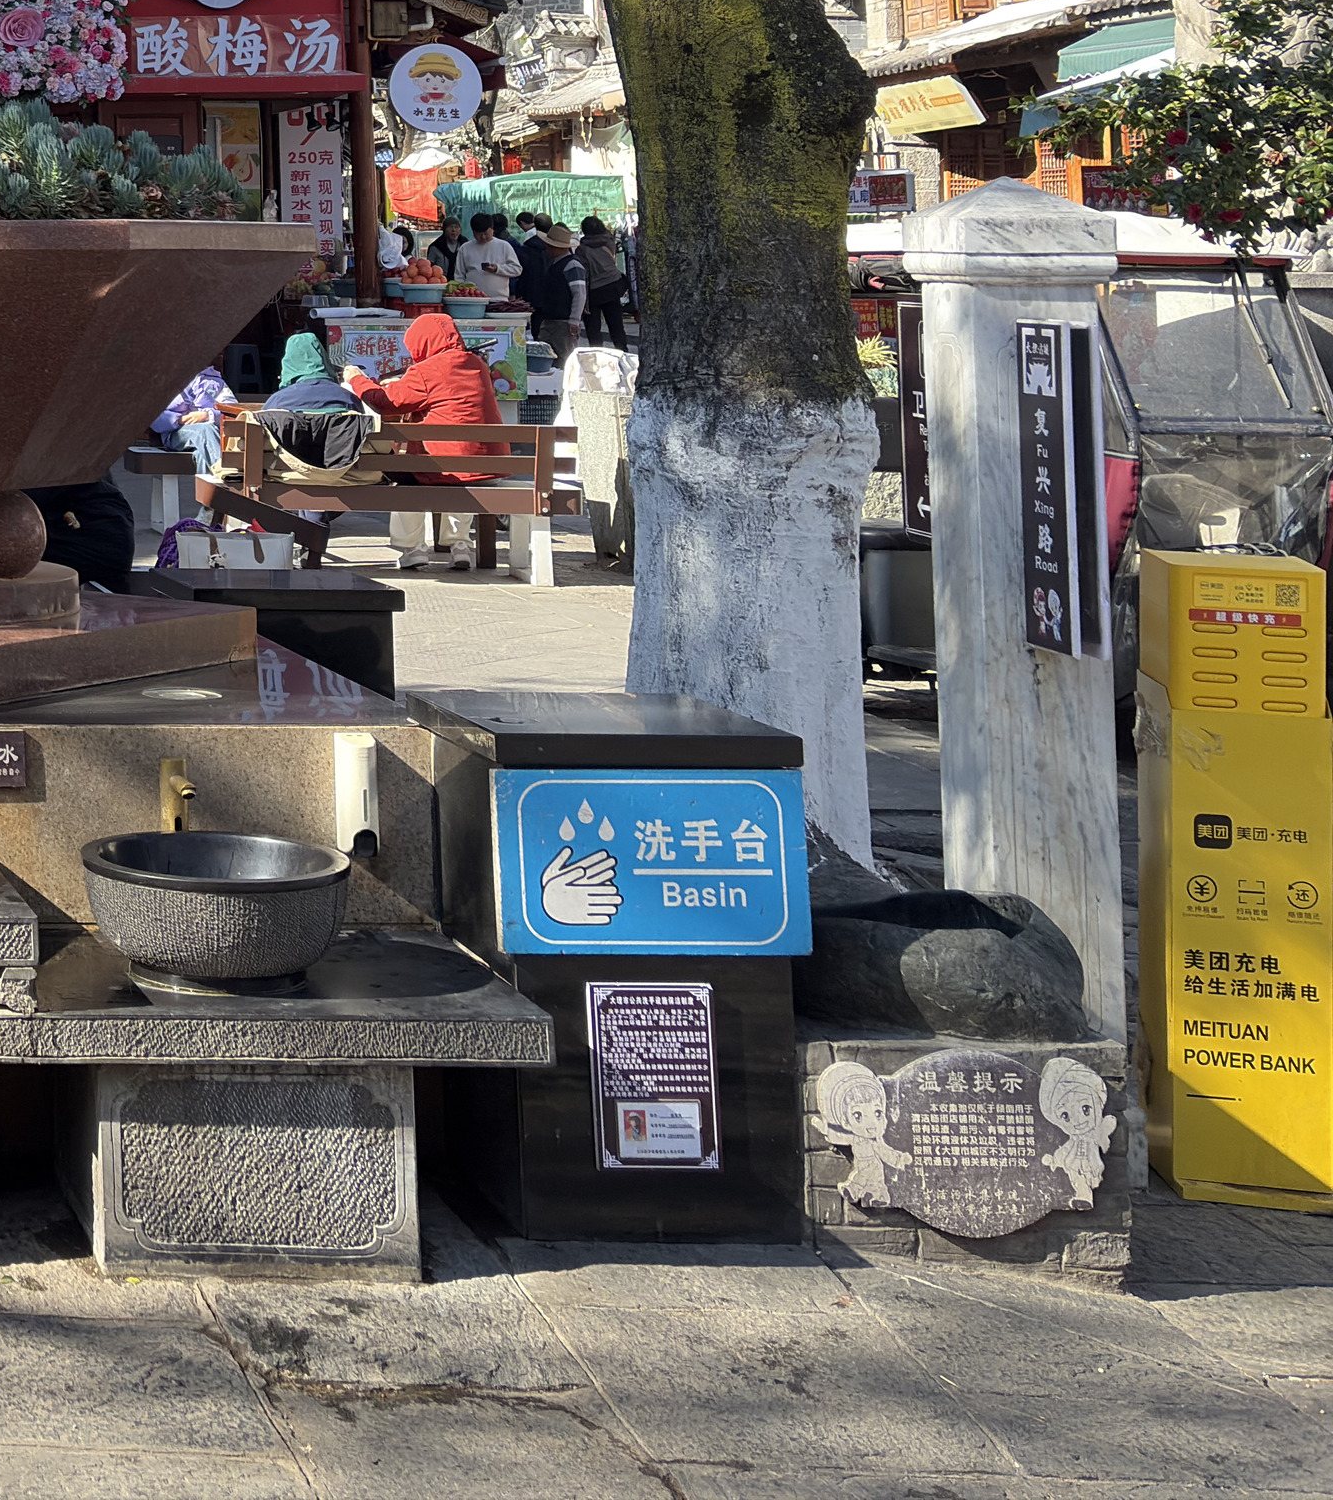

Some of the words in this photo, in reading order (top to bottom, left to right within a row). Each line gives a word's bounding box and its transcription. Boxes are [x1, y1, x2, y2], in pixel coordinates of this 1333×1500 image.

[134, 17, 340, 76] 酸梅汤
[413, 108, 461, 119] 水果先生
[287, 150, 334, 165] 250克
[318, 180, 335, 255] 现切现卖
[355, 335, 399, 356] 新鲜
[1034, 408, 1049, 437] 复
[1036, 443, 1049, 459] Fu
[1035, 466, 1052, 495] 兴
[1034, 498, 1055, 519] Xing
[1038, 523, 1054, 554] 路
[1035, 555, 1059, 574] Road
[1215, 611, 1276, 625] 超级快充
[634, 817, 769, 863] 洗手台
[1197, 824, 1229, 839] 美团
[662, 881, 747, 908] Basin
[1294, 888, 1311, 902] 还
[1184, 948, 1282, 975] 美团充电
[1184, 975, 1320, 1003] 给生活加满电
[1183, 1019, 1270, 1042] MEITUAN
[1184, 1048, 1256, 1071] POWER
[1259, 1054, 1317, 1075] BANK
[918, 1071, 1024, 1093] 温馨提示
